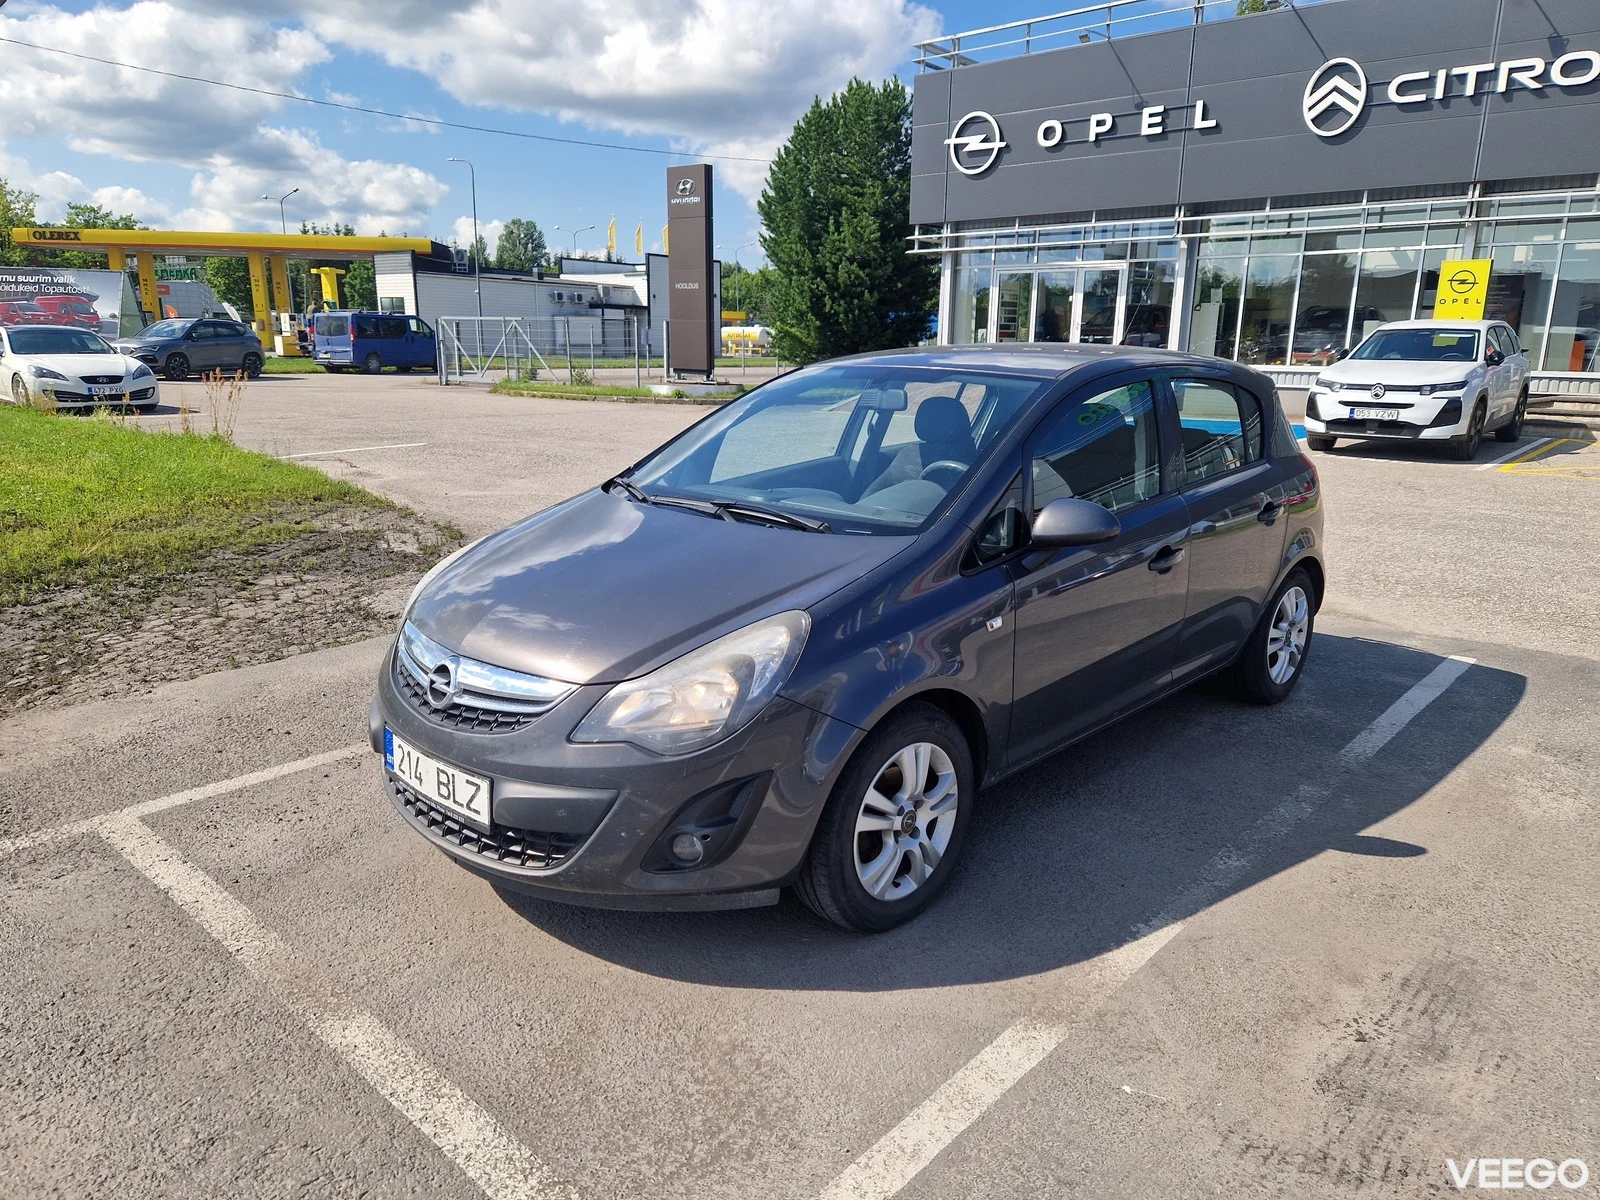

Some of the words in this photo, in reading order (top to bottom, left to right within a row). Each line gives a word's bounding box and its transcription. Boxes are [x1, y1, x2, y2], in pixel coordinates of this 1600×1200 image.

[1037, 101, 1218, 148] OPEL
[32, 231, 81, 240] OLEREX
[17, 274, 51, 283] suurim
[53, 274, 76, 284] valik
[1356, 409, 1371, 417] 053
[1375, 410, 1396, 418] VZW
[398, 744, 423, 787] 214
[437, 767, 481, 815] BLZ
